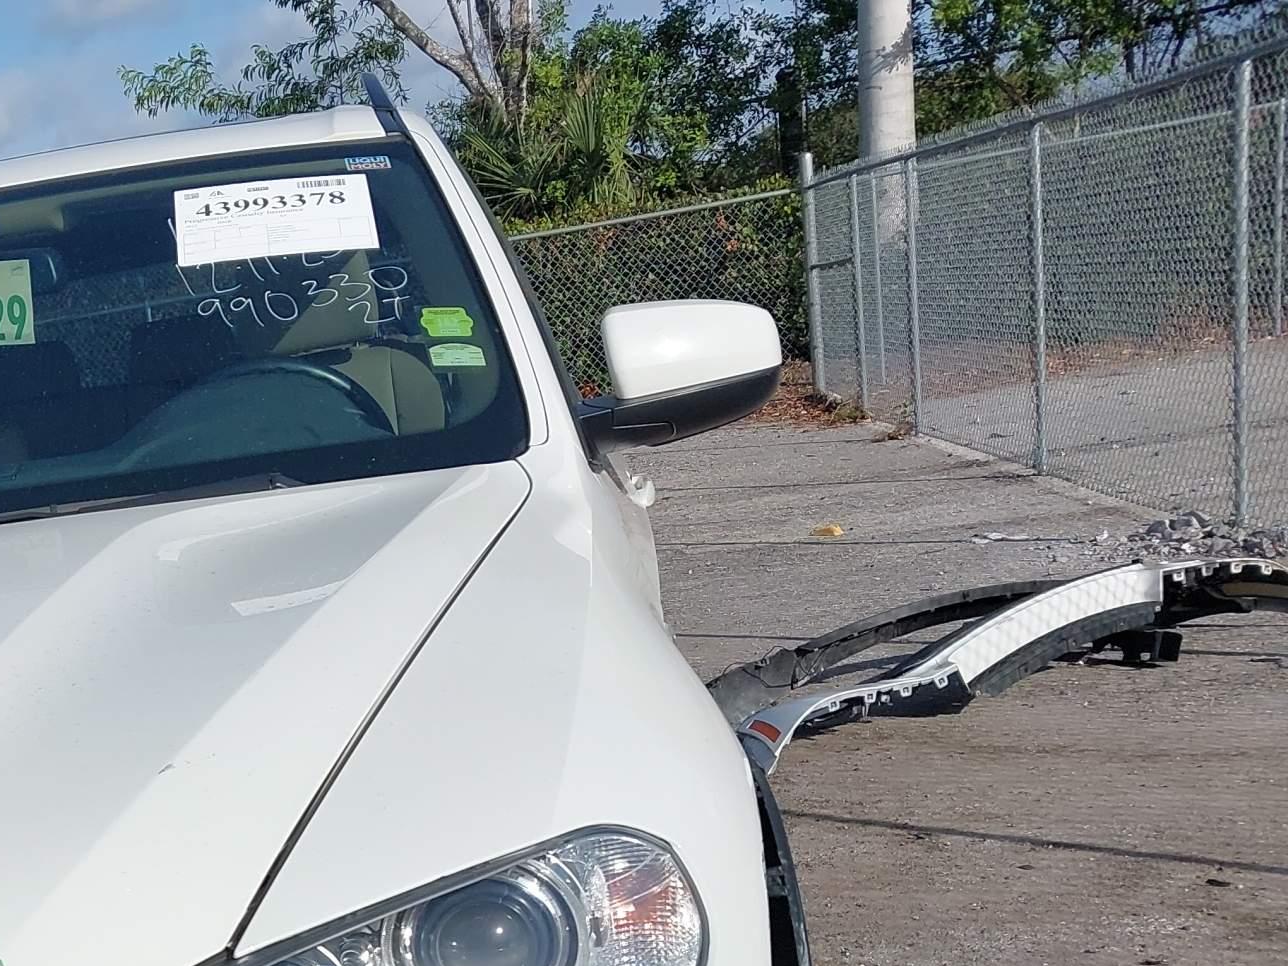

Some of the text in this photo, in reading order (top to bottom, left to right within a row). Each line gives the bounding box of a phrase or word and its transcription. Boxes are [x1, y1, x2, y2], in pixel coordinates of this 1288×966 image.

[351, 162, 386, 170] MOLY
[195, 190, 346, 217] 43993378
[197, 265, 409, 328] 990330
